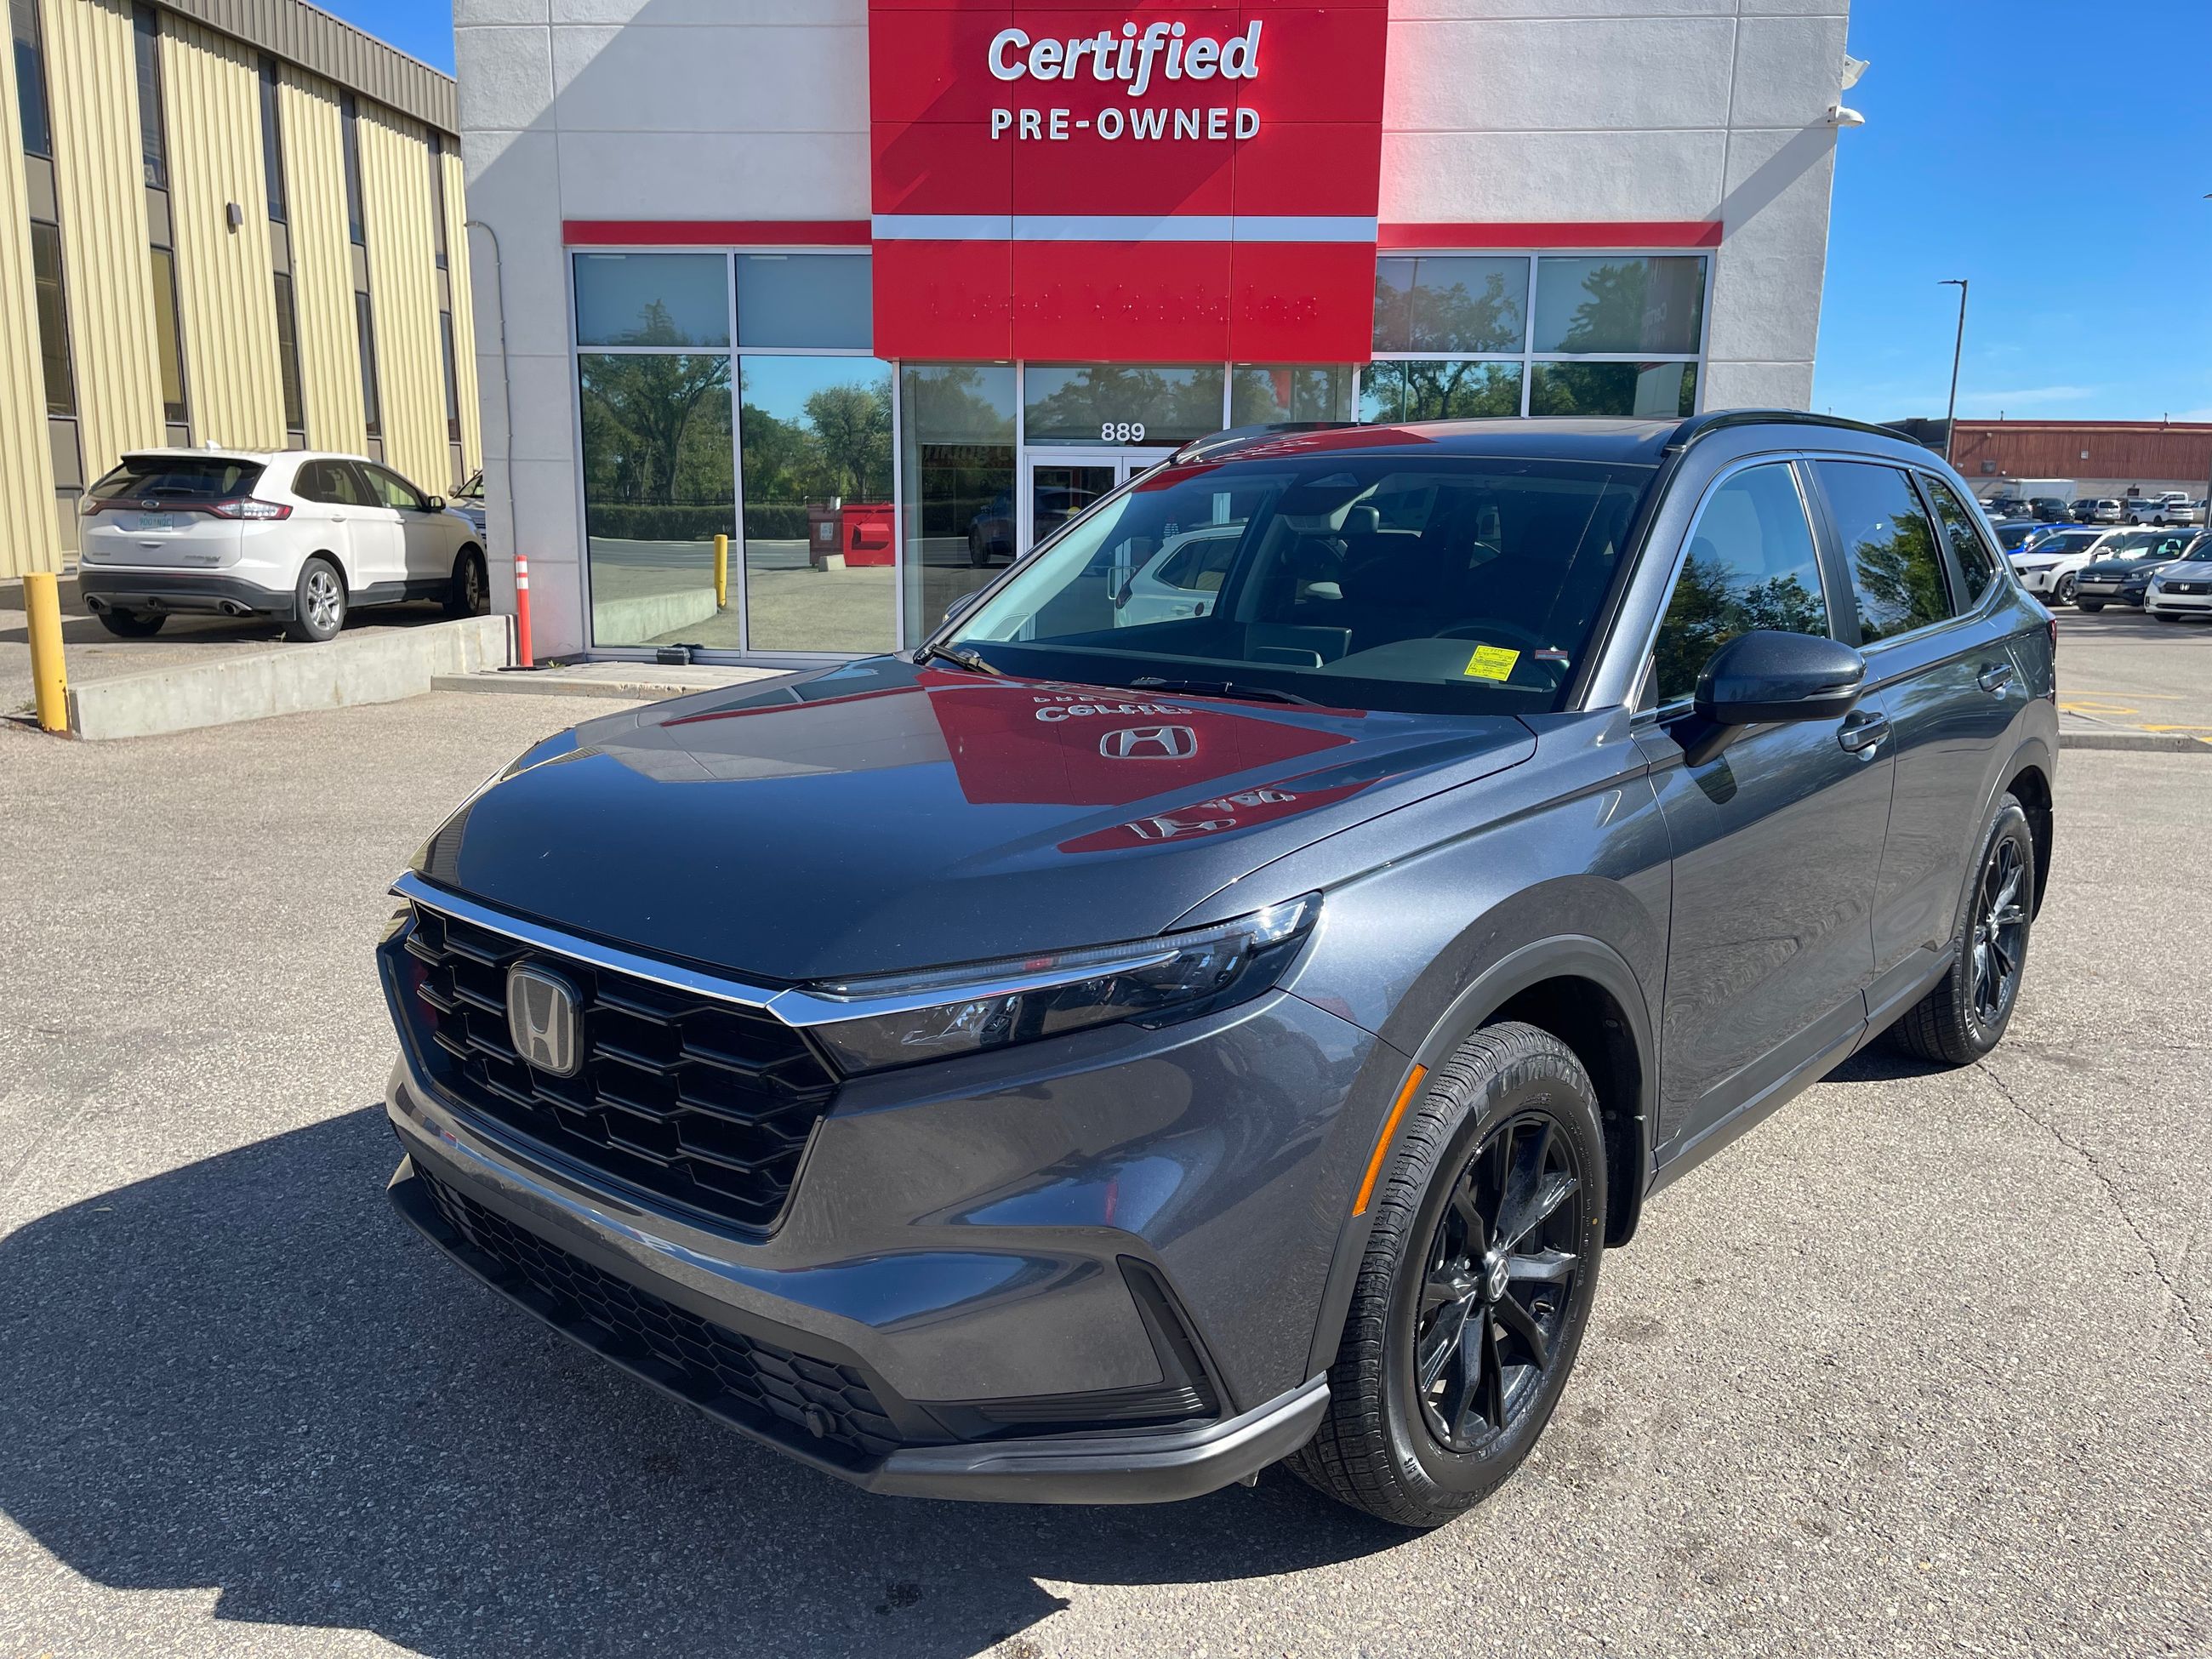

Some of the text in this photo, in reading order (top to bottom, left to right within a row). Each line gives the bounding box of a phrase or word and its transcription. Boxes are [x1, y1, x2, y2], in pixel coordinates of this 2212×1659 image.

[988, 20, 1263, 97] Certified
[991, 107, 1260, 140] PRE-OWNED
[1101, 422, 1145, 442] 889
